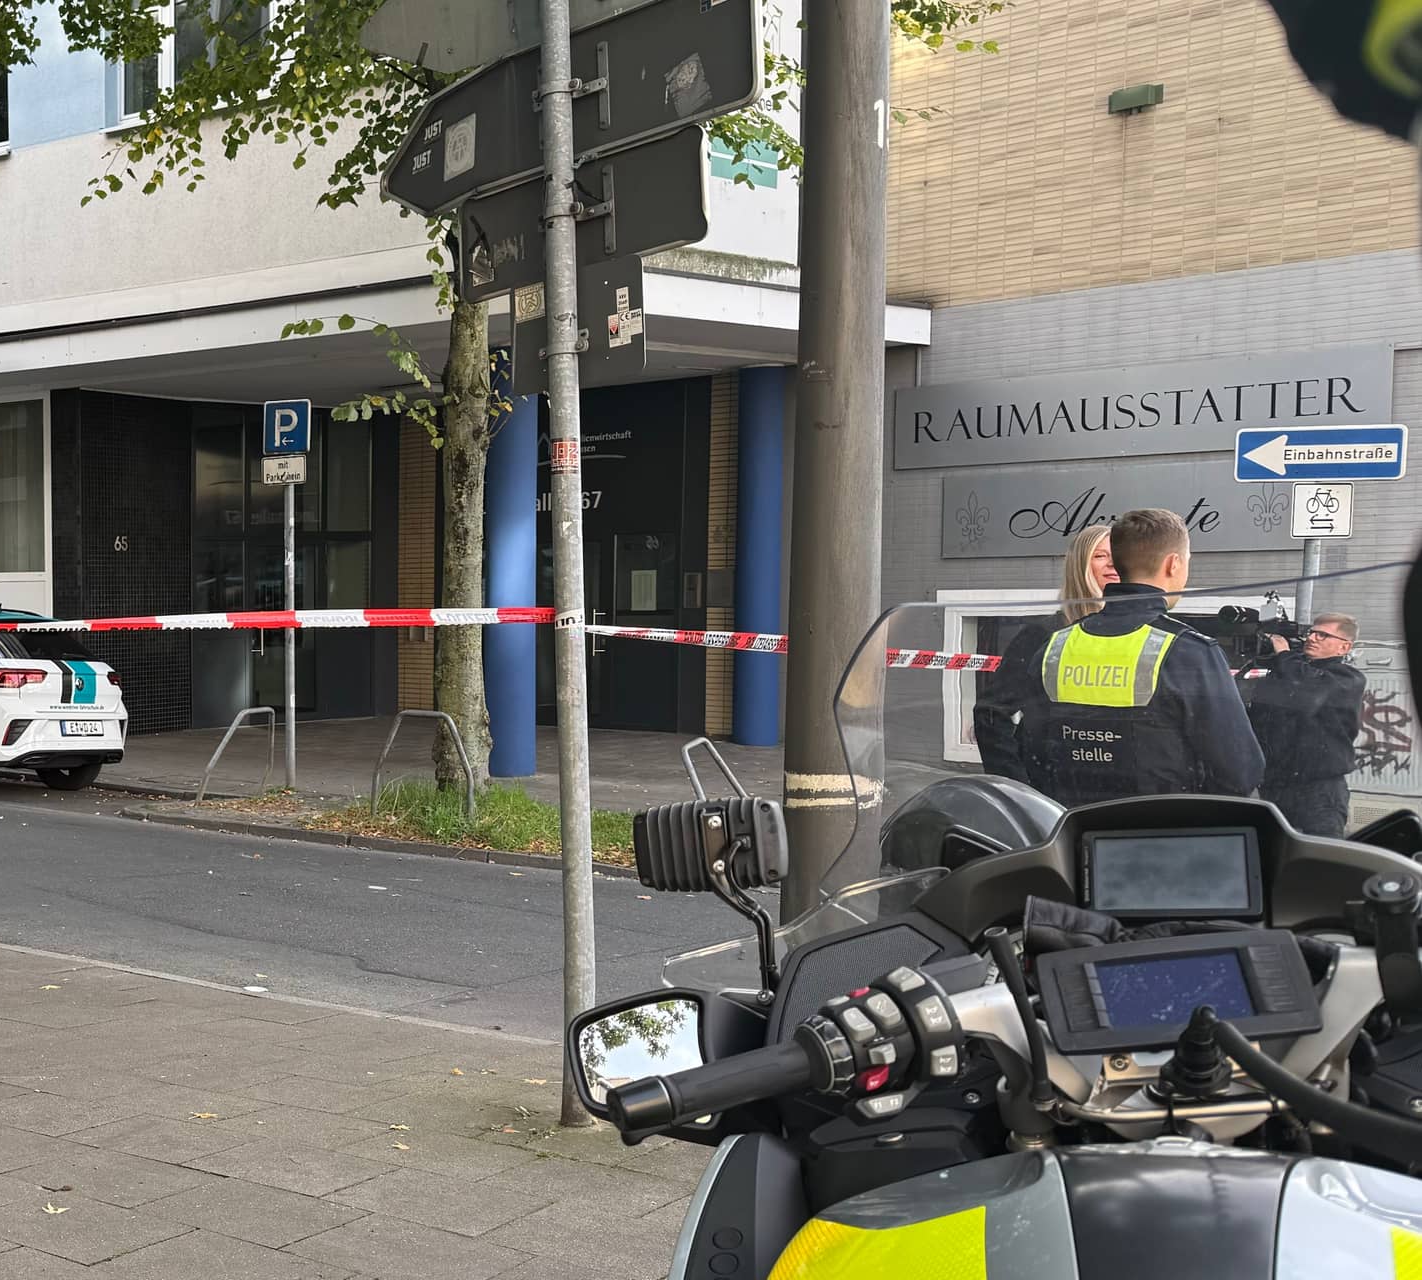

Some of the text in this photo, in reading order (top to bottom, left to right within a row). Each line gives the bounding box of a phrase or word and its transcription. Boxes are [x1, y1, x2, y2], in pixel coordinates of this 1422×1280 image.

[424, 119, 443, 141] JUST
[412, 149, 432, 171] JUST
[913, 376, 1366, 443] RAUMAUSSTATTER
[274, 408, 298, 447] P
[1283, 447, 1393, 461] Einbahnstraße
[278, 460, 289, 469] mit
[114, 535, 128, 551] 65
[1062, 665, 1129, 688] POLIZEI
[1062, 724, 1122, 743] Presse-
[1072, 747, 1113, 762] stelle
